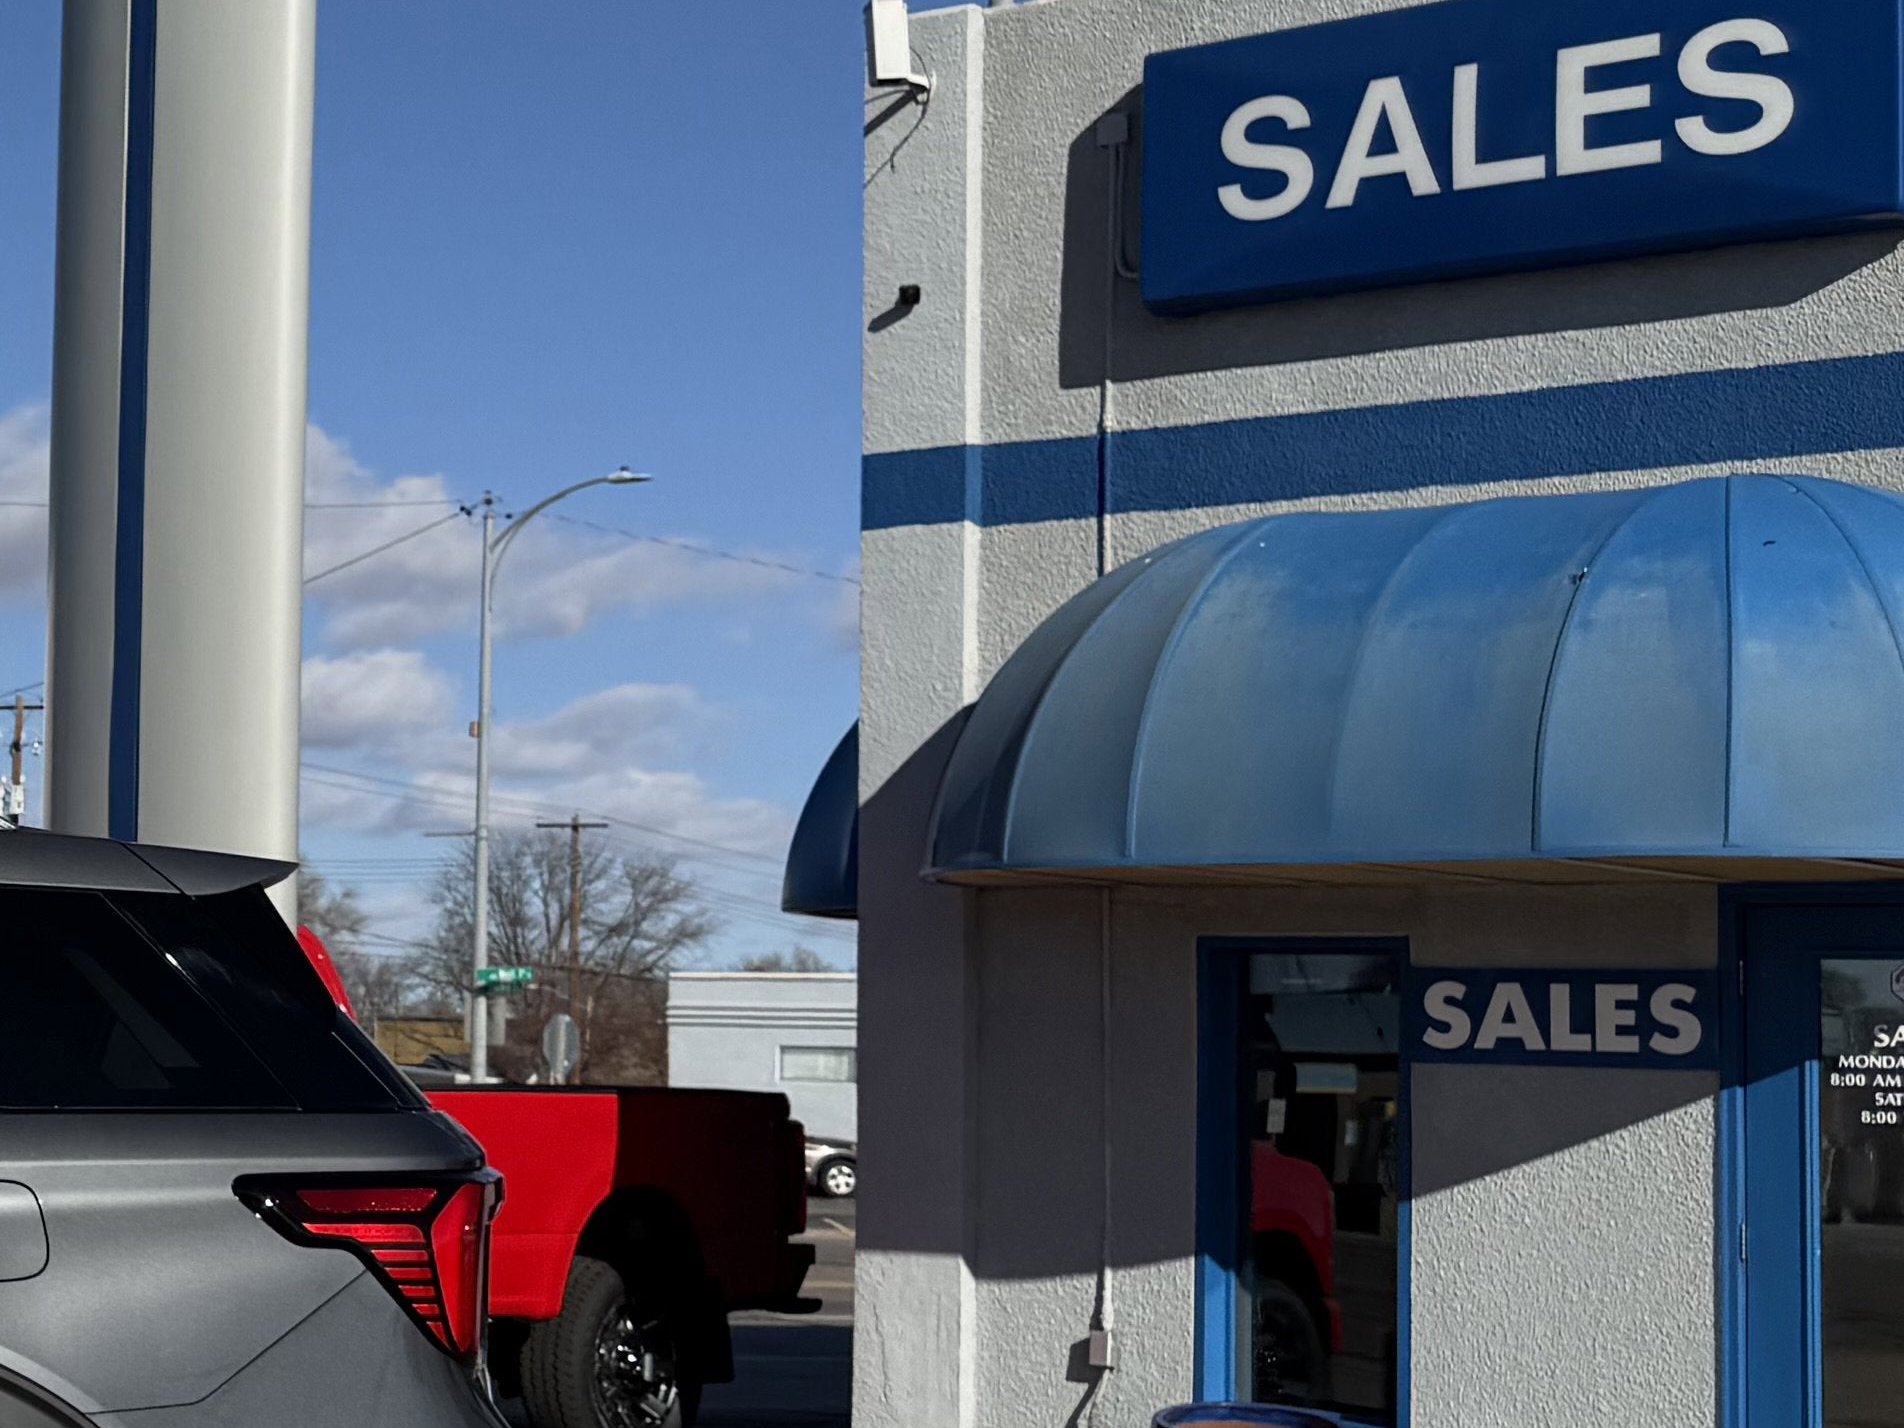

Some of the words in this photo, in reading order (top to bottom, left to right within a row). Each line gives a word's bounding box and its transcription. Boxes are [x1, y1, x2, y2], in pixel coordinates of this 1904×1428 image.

[1217, 18, 1795, 221] SALES
[1422, 980, 1702, 1055] SALES
[1830, 1073, 1866, 1087] 8:00
[1872, 1073, 1902, 1087] AM
[1861, 1110, 1897, 1124] 8:00
